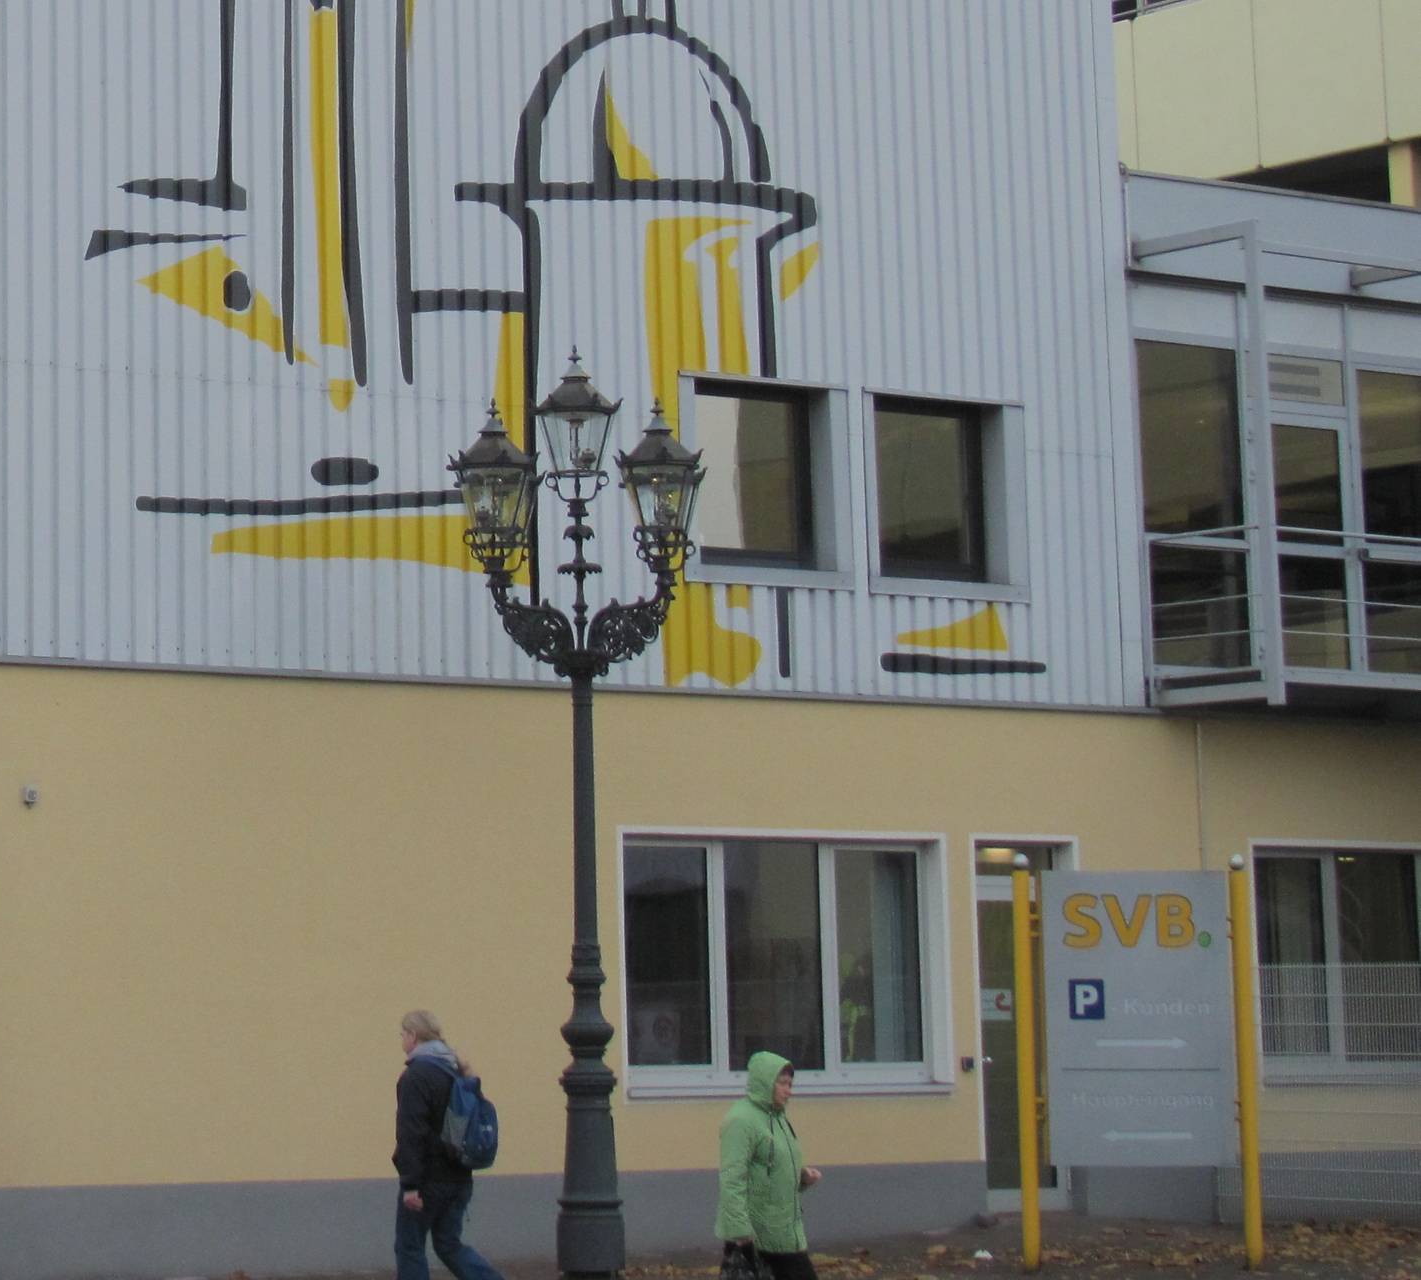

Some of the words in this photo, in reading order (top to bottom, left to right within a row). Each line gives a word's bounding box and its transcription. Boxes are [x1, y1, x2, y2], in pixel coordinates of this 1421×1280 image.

[1062, 893, 1212, 949] SVB.
[1074, 984, 1099, 1016] P
[1123, 997, 1211, 1016] Kunden
